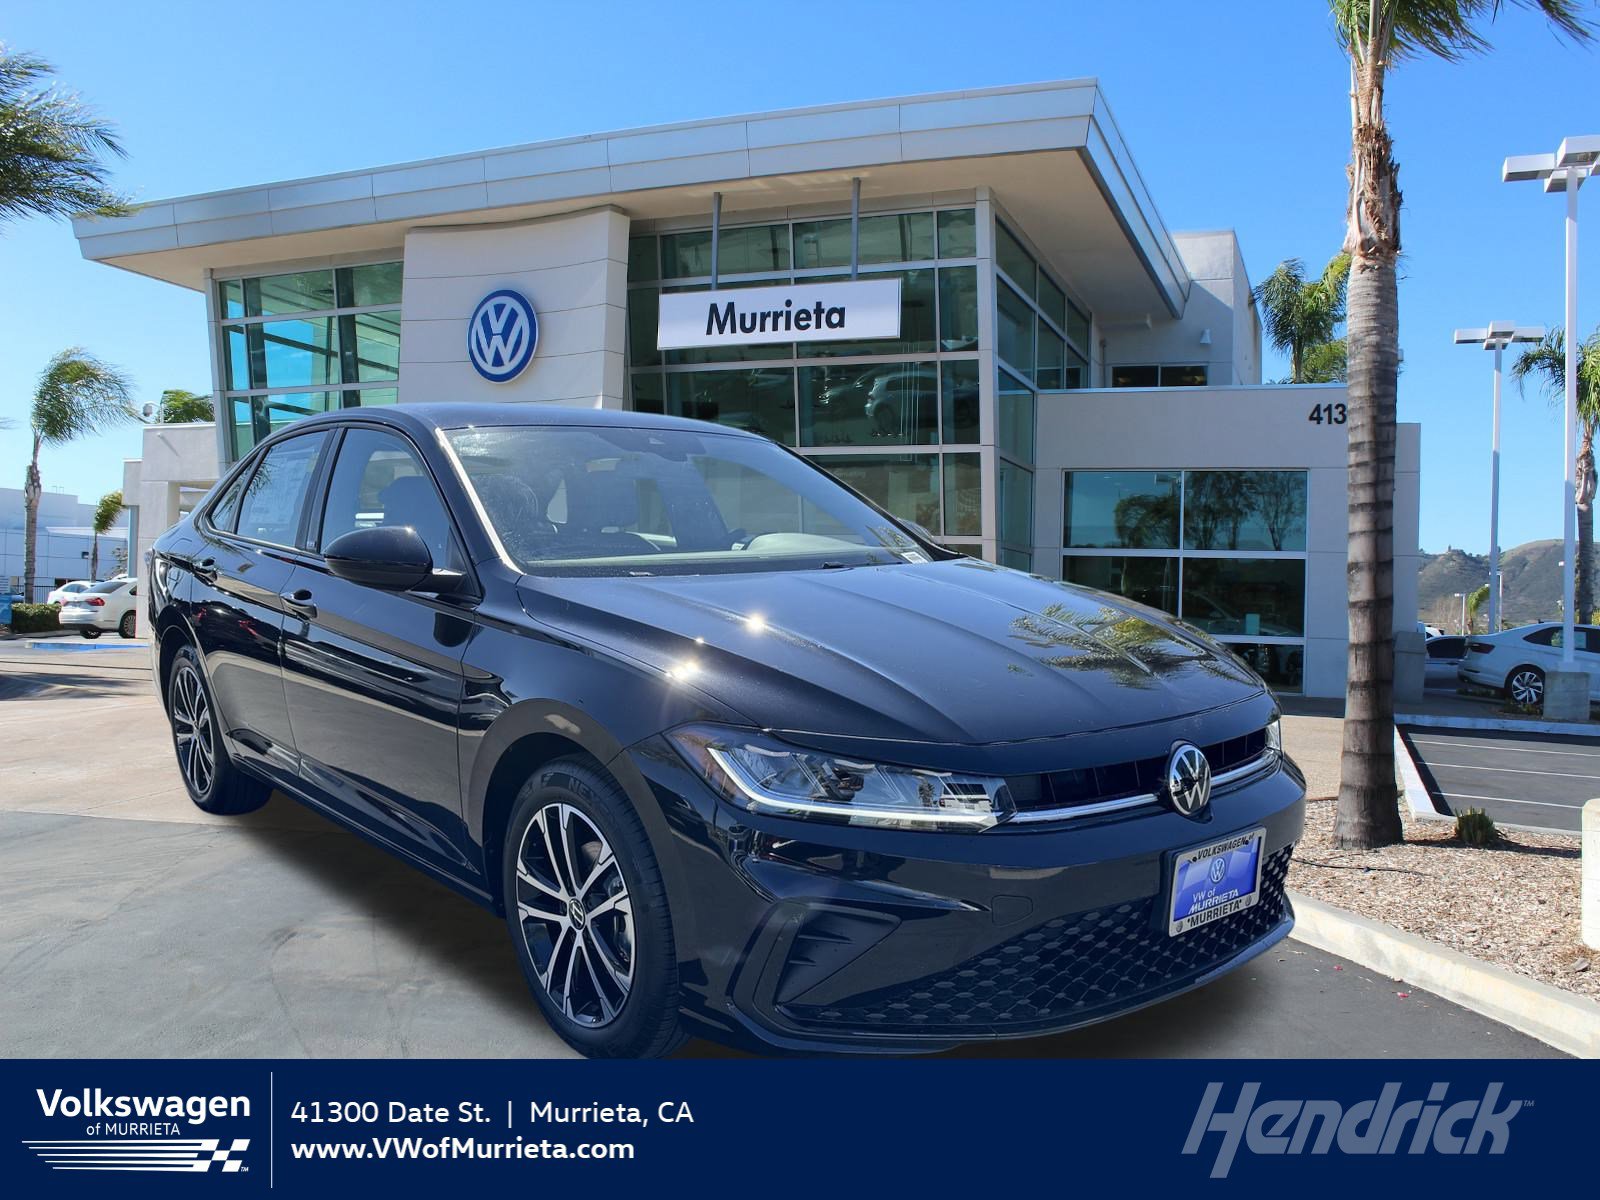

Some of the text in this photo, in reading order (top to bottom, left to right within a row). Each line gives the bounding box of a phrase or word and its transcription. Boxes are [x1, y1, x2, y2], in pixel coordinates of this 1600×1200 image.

[706, 299, 846, 336] Murrieta
[1308, 403, 1347, 425] 413
[1197, 836, 1248, 860] VOLKSWAGEN
[1188, 888, 1239, 915] MURRIETA
[1192, 886, 1217, 903] VW of
[1190, 901, 1240, 927] MURRIETA
